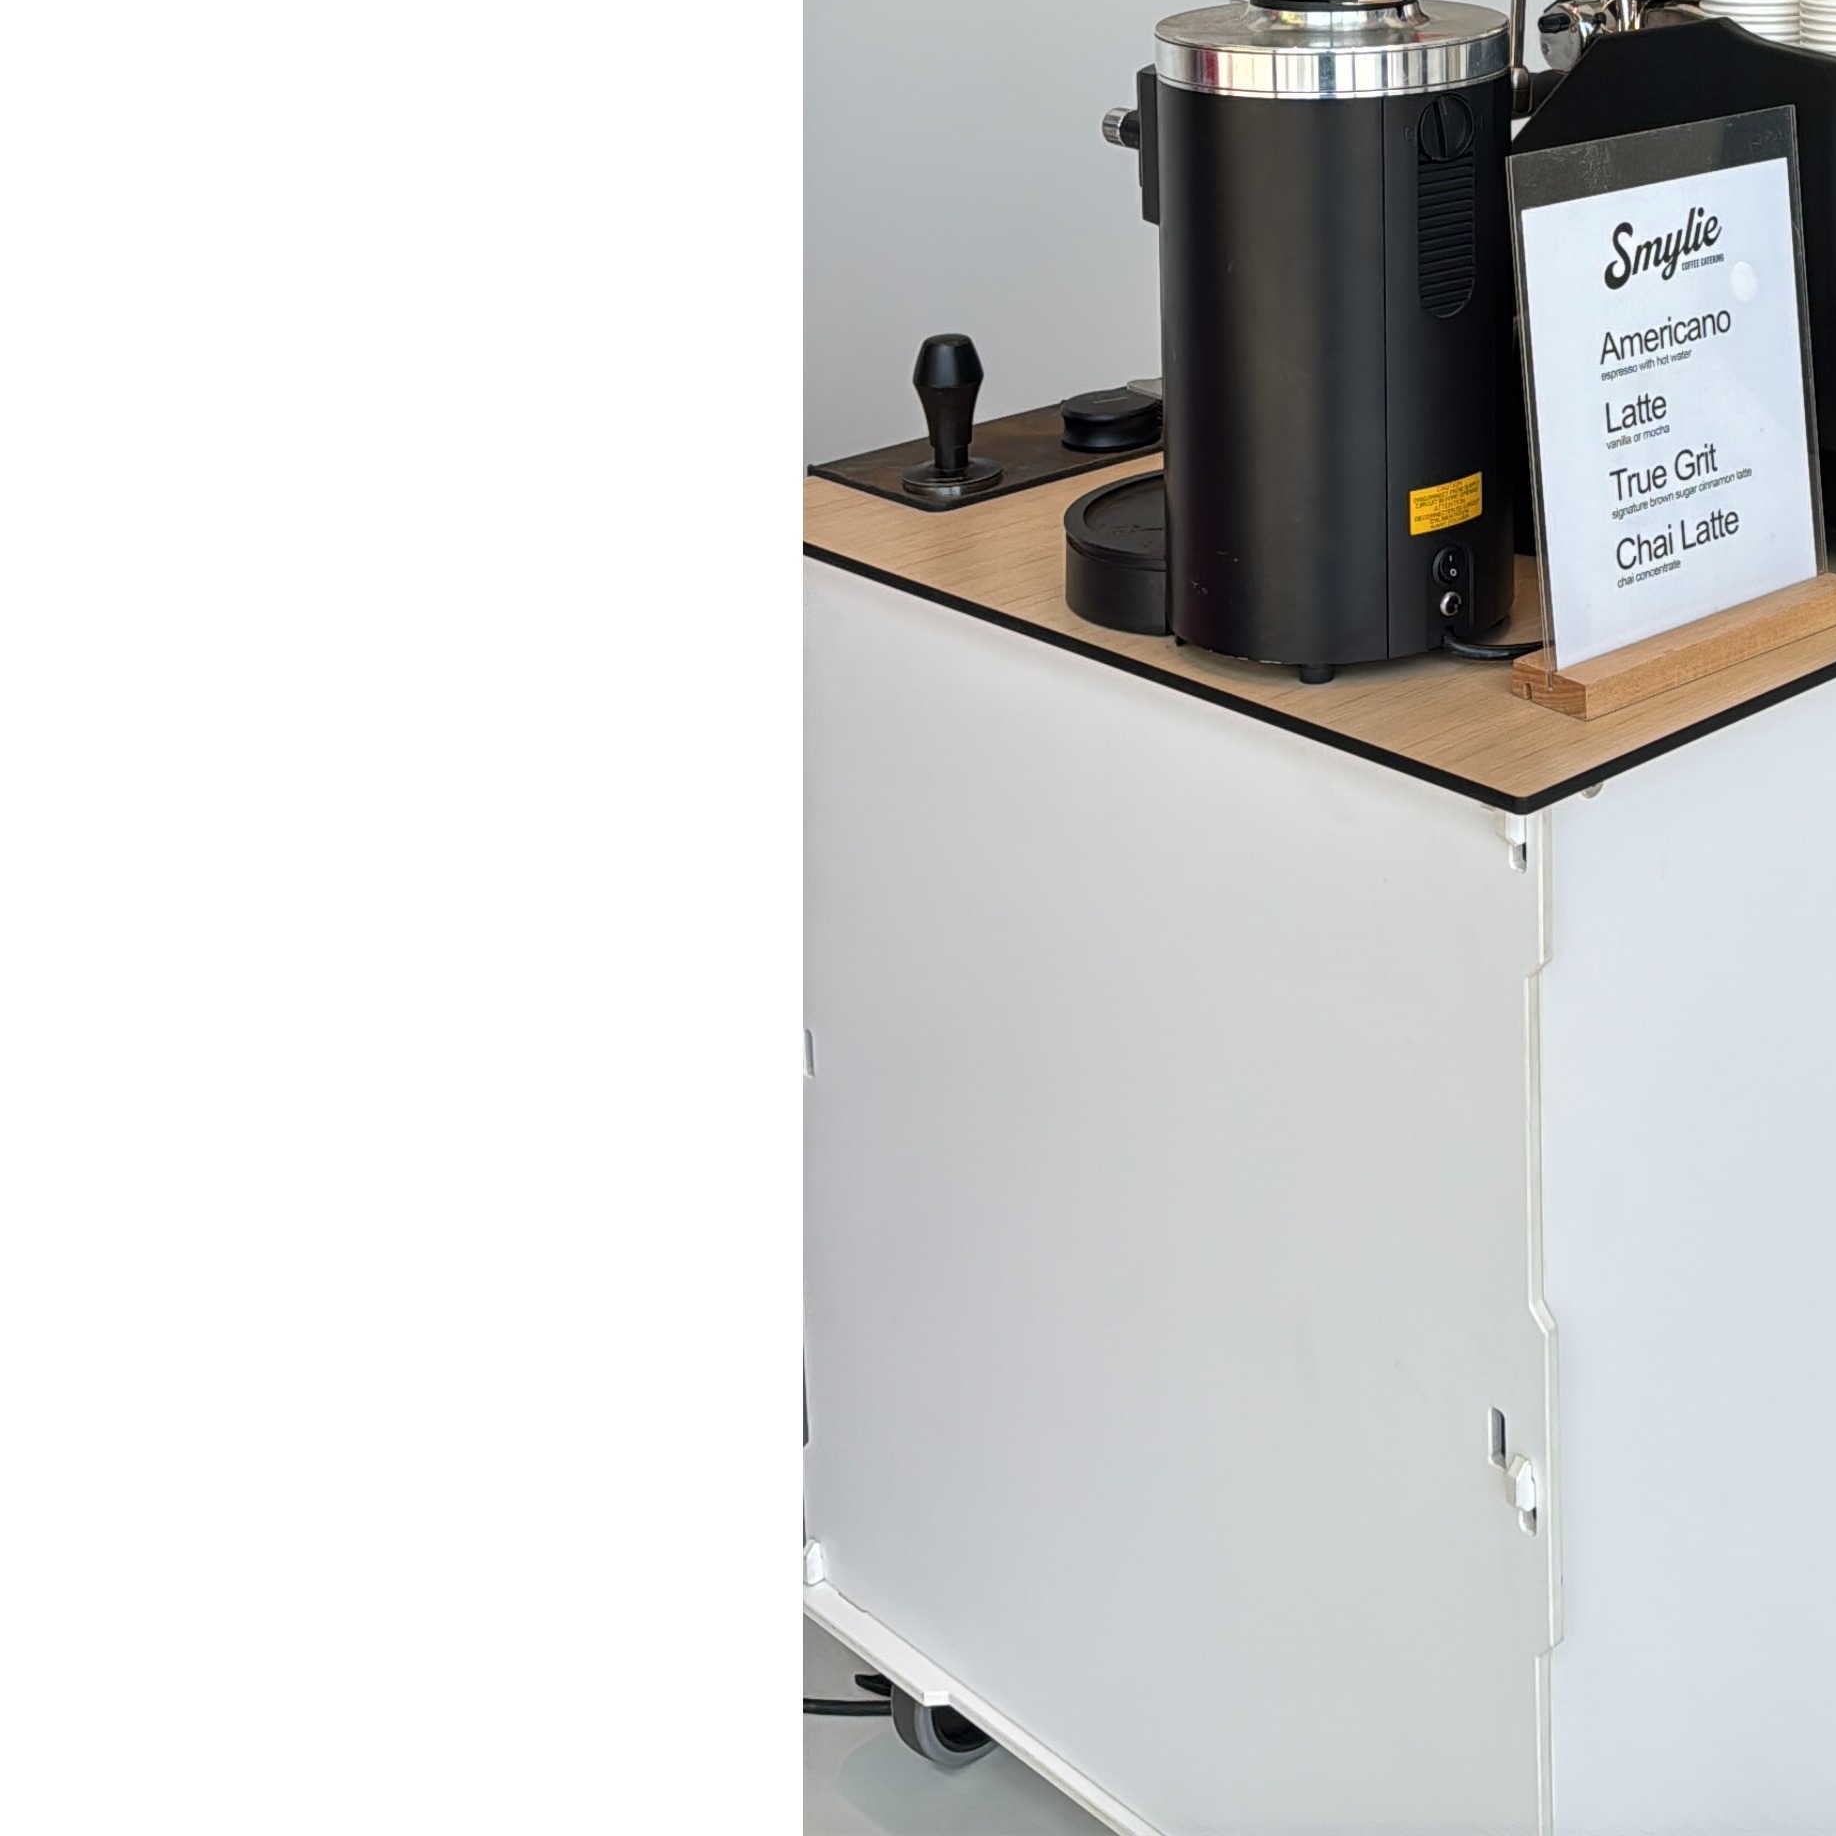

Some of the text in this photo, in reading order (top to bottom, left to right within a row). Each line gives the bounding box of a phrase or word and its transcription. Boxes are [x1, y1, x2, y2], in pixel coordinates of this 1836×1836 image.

[1604, 207, 1722, 290] Smylie
[1681, 253, 1724, 271] COFFEE CATERING
[1600, 310, 1731, 365] Americano
[1601, 349, 1692, 381] espresso with hot water
[1605, 392, 1667, 433] Latte
[1606, 424, 1670, 450] vanilla or mocha
[1609, 442, 1718, 501] True Grit
[1611, 467, 1752, 520] signature brown sugar cinnamon latte
[1616, 508, 1739, 570] Chai Latte
[1617, 560, 1681, 588] chai concentrate
